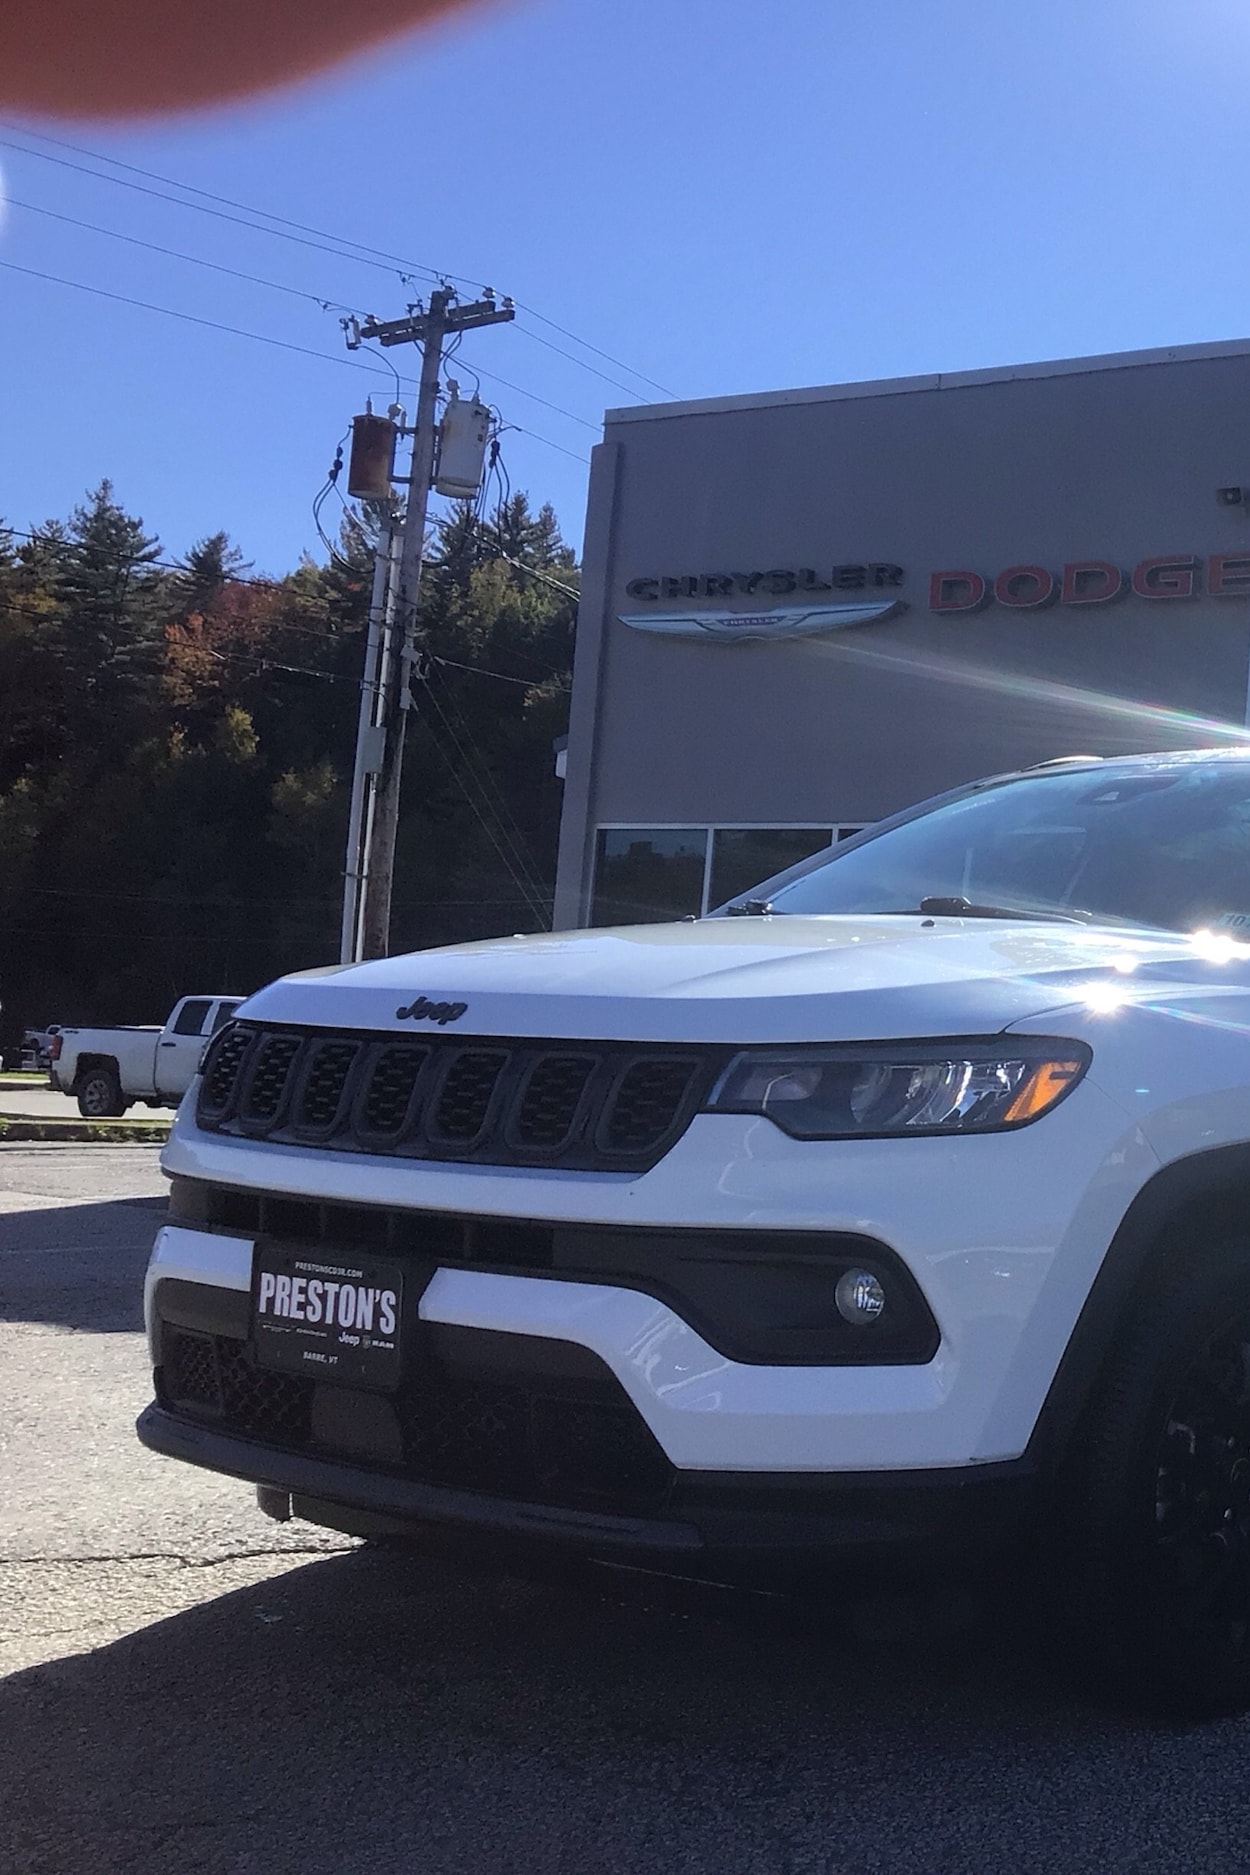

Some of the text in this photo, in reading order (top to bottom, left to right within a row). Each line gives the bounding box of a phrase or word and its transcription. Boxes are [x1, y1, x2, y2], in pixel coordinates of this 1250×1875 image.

[625, 562, 904, 601] CHRYSLER
[396, 996, 468, 1025] Jeep
[258, 1272, 397, 1334] PRESTON'S
[338, 1331, 360, 1347] Jeep
[328, 1355, 338, 1364] VT
